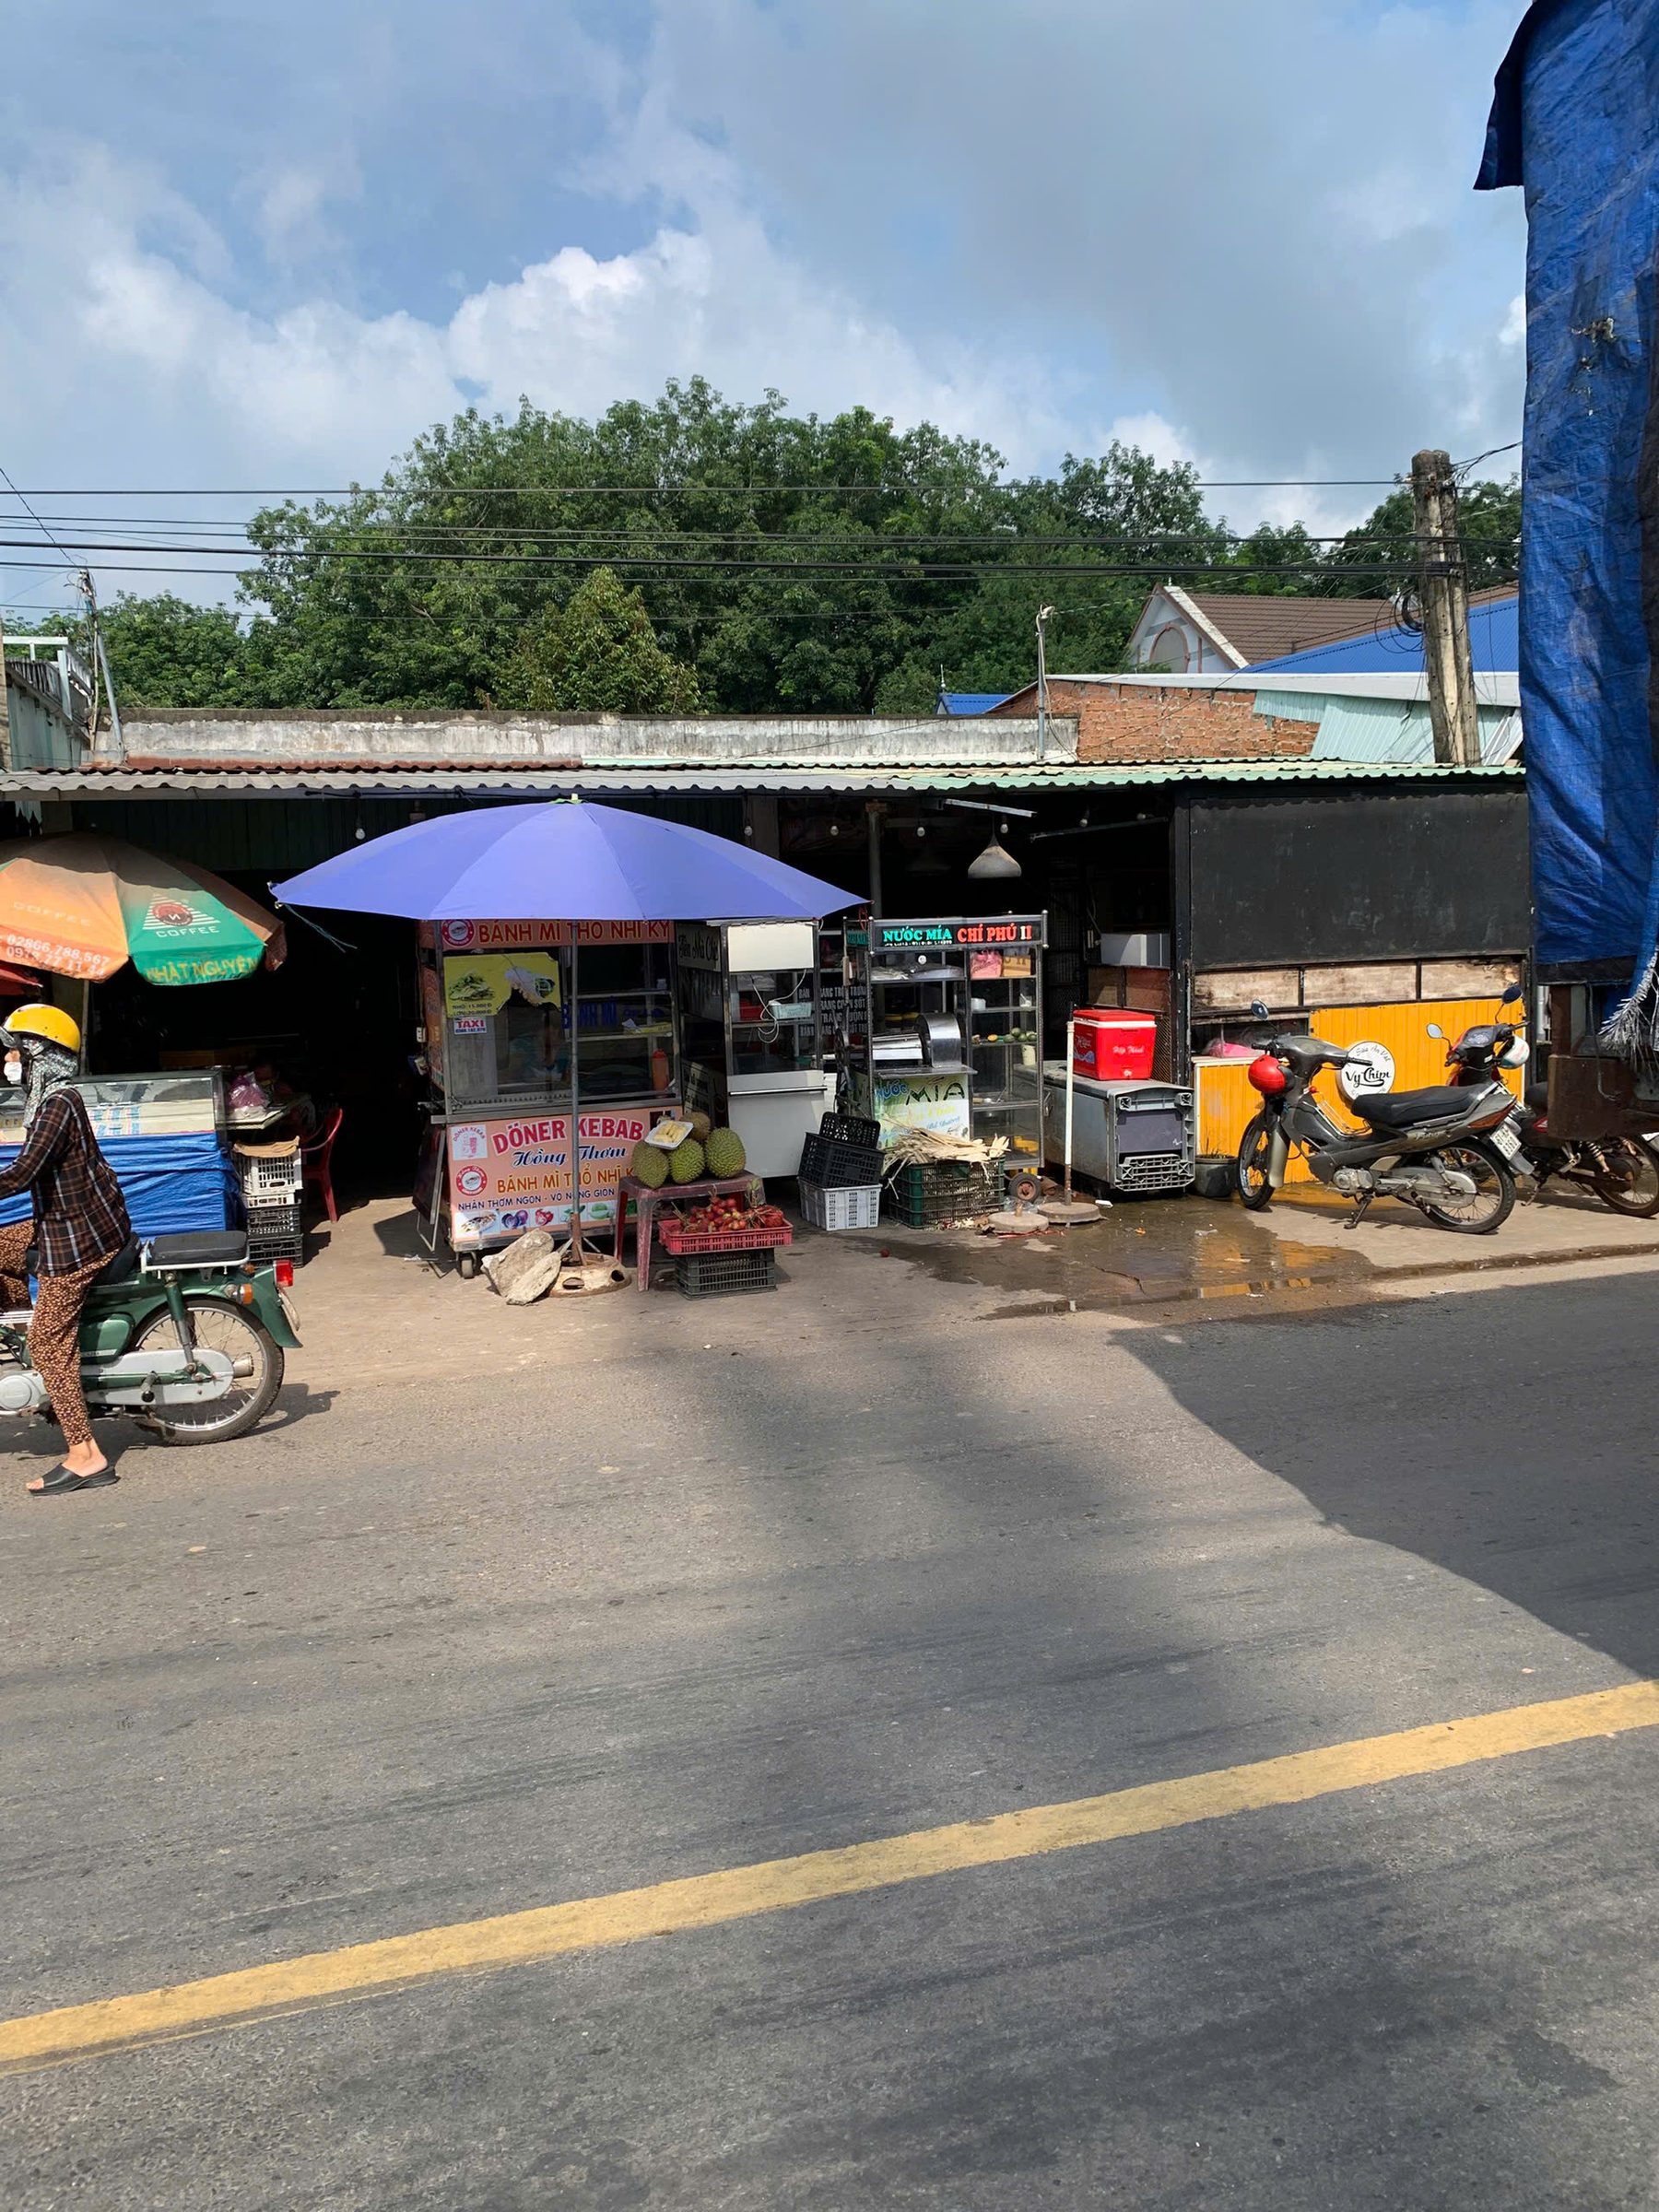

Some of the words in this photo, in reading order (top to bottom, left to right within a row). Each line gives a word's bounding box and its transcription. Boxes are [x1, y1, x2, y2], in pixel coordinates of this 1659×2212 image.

[155, 925, 220, 937] COFFEE
[882, 926, 923, 942] NƯỚC
[926, 924, 953, 940] MÍA
[957, 923, 983, 943] CHÍ
[986, 923, 1017, 942] PHÚ
[457, 1019, 485, 1029] TAXI
[1346, 1070, 1362, 1088] Vy
[906, 1076, 965, 1106] MÍA
[492, 1120, 567, 1154] DÖNER
[512, 1148, 567, 1166] Hồng
[578, 1145, 627, 1160] Thơm
[497, 1174, 538, 1194] BÁNH
[543, 1171, 559, 1189] MÌ
[488, 1197, 513, 1208] THƠM
[516, 1194, 541, 1206] NGON
